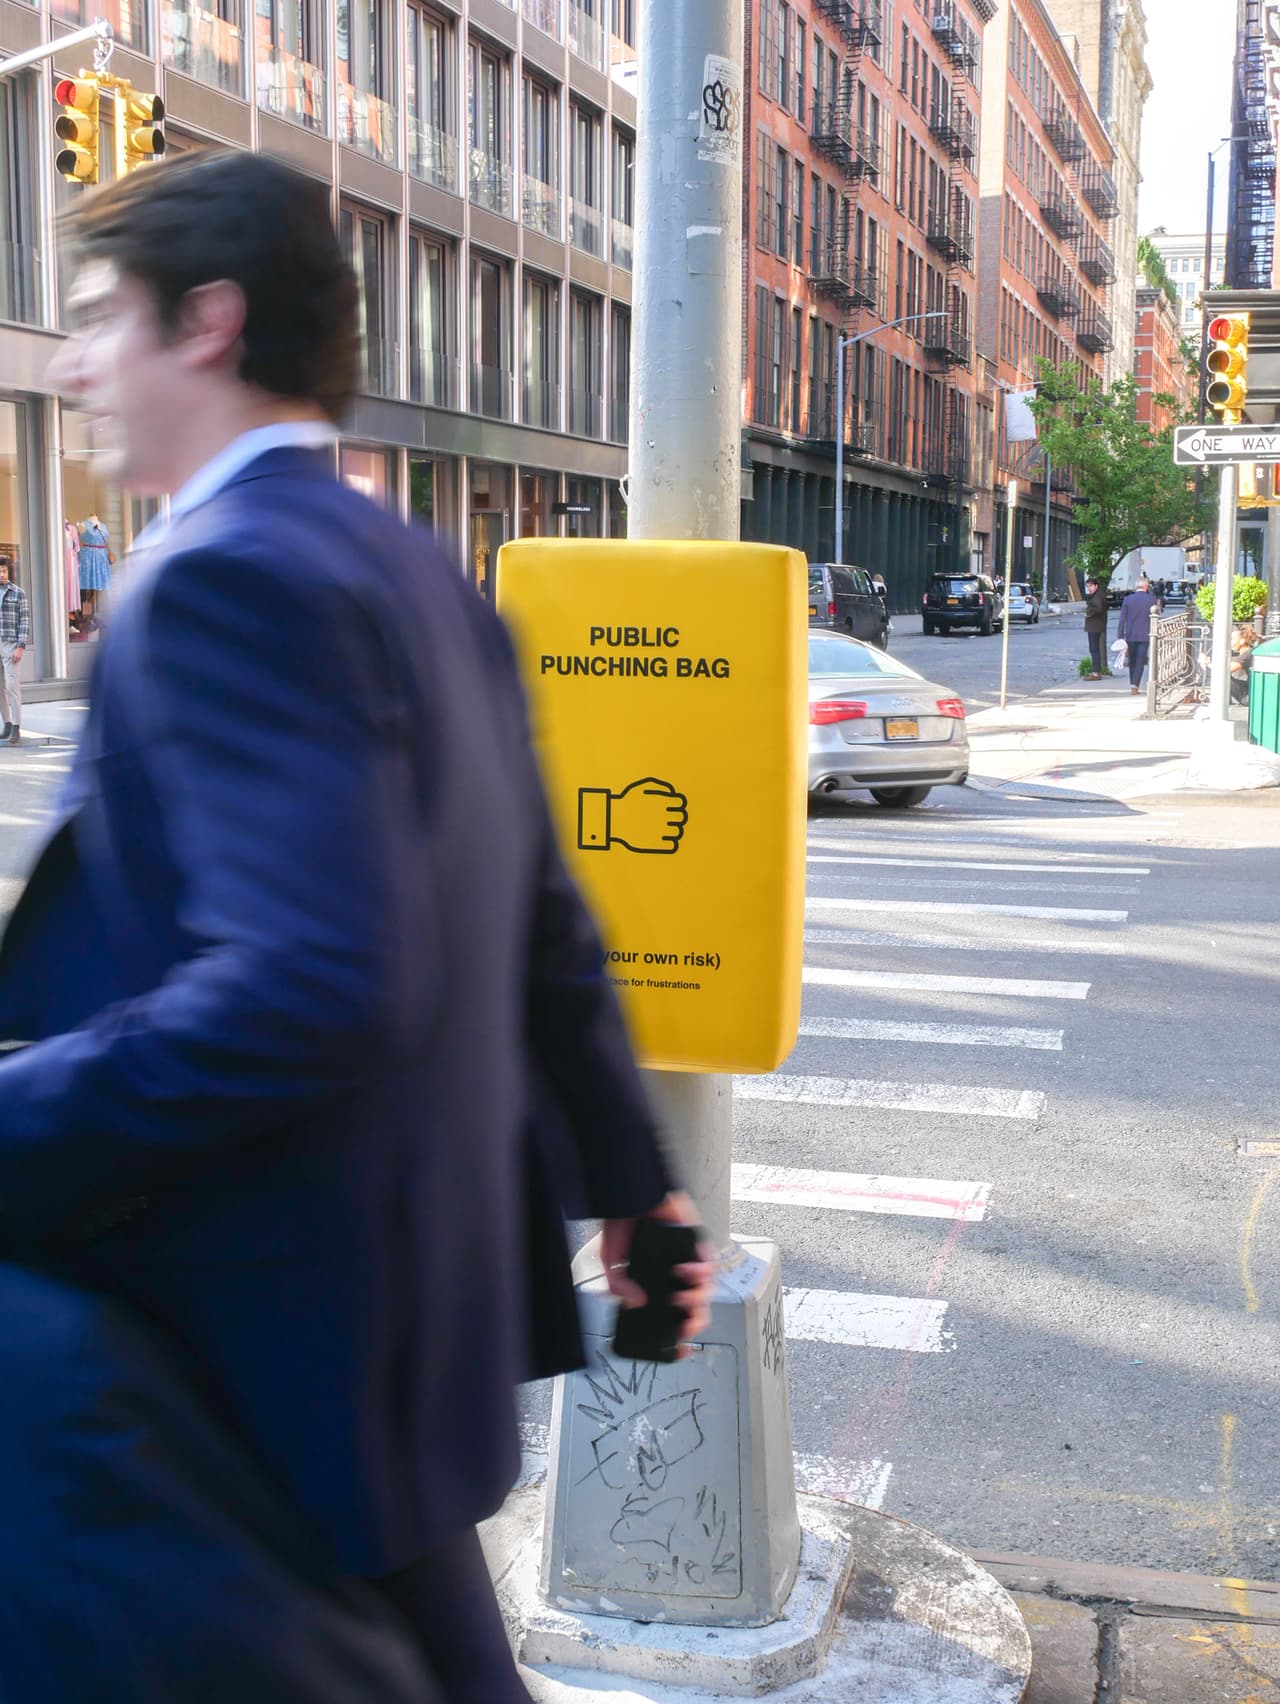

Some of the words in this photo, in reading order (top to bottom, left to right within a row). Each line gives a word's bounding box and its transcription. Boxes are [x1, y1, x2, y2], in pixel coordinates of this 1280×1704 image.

[1191, 438, 1223, 452] ONE
[1242, 437, 1277, 451] WAY
[590, 626, 680, 648] PUBLIC
[540, 655, 668, 677] PUNCHING
[676, 658, 730, 679] BAG
[601, 951, 639, 965] your
[643, 952, 678, 965] own
[684, 952, 721, 970] risk)
[631, 978, 644, 987] for
[646, 978, 701, 990] frustrations
